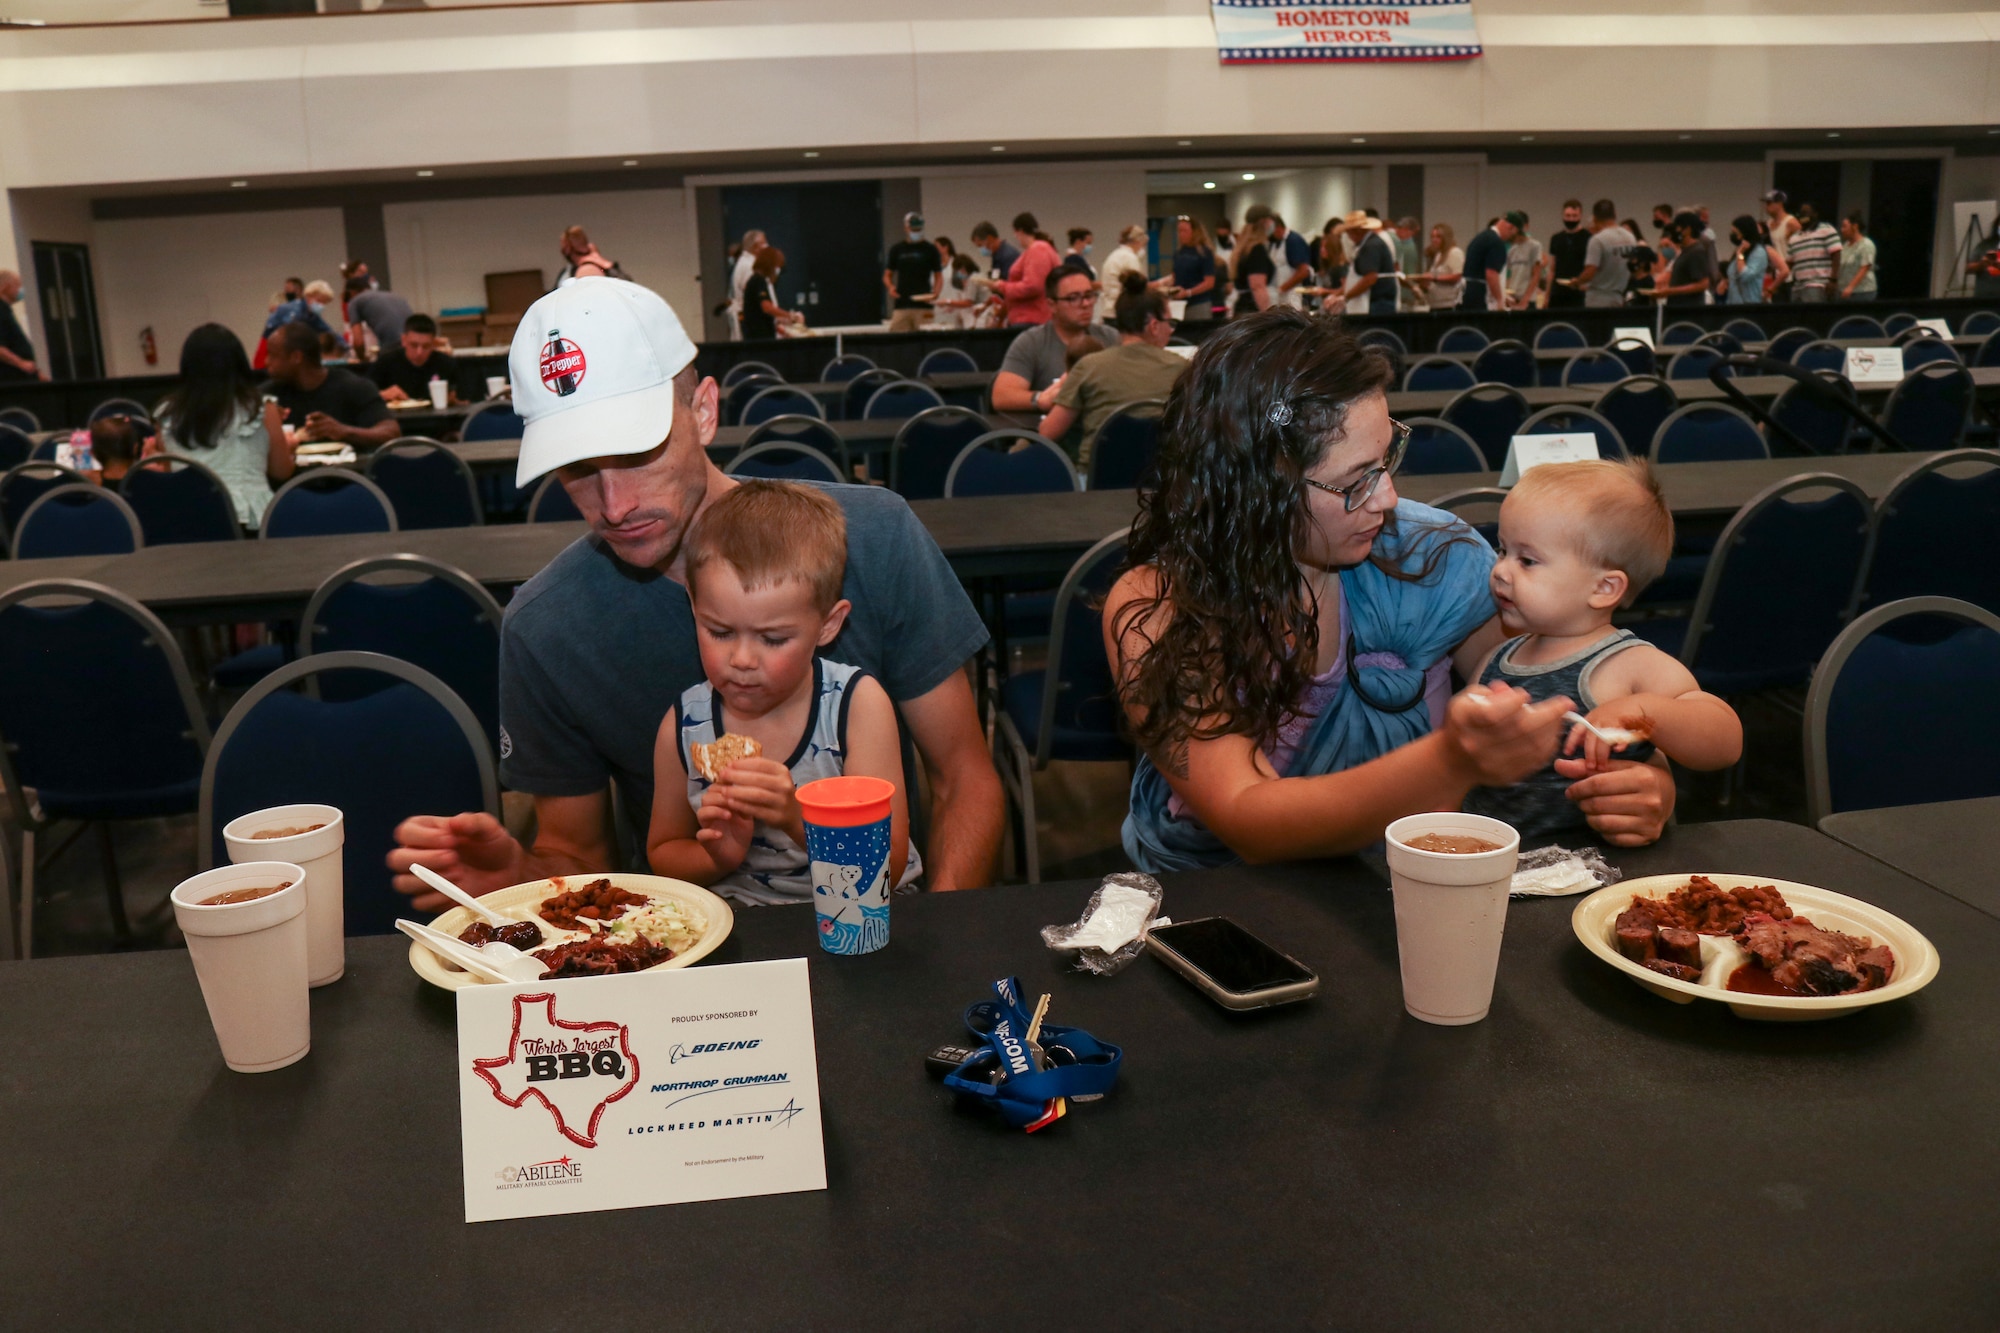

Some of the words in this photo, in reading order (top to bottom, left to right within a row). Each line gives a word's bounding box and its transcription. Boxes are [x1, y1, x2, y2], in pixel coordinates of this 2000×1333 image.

[1276, 10, 1410, 27] HOMETOWN
[1303, 30, 1392, 43] HEROES
[550, 356, 581, 372] Pepper
[671, 1014, 704, 1023] PROUDLY
[705, 1010, 748, 1021] SPONSORED
[749, 1009, 758, 1017] BY
[571, 1035, 618, 1054] Largest
[691, 1039, 760, 1054] BOEING
[525, 1050, 626, 1082] BBQ
[650, 1079, 719, 1093] NORTHROP
[723, 1073, 788, 1086] GRUMMAN
[628, 1121, 705, 1135] LOCKHEED
[713, 1114, 773, 1128] MARTIN
[701, 1157, 731, 1165] Endorsement
[516, 1163, 582, 1181] ABILENE
[524, 1180, 547, 1188] AFFAIRS
[547, 1177, 583, 1186] COMMITTEE
